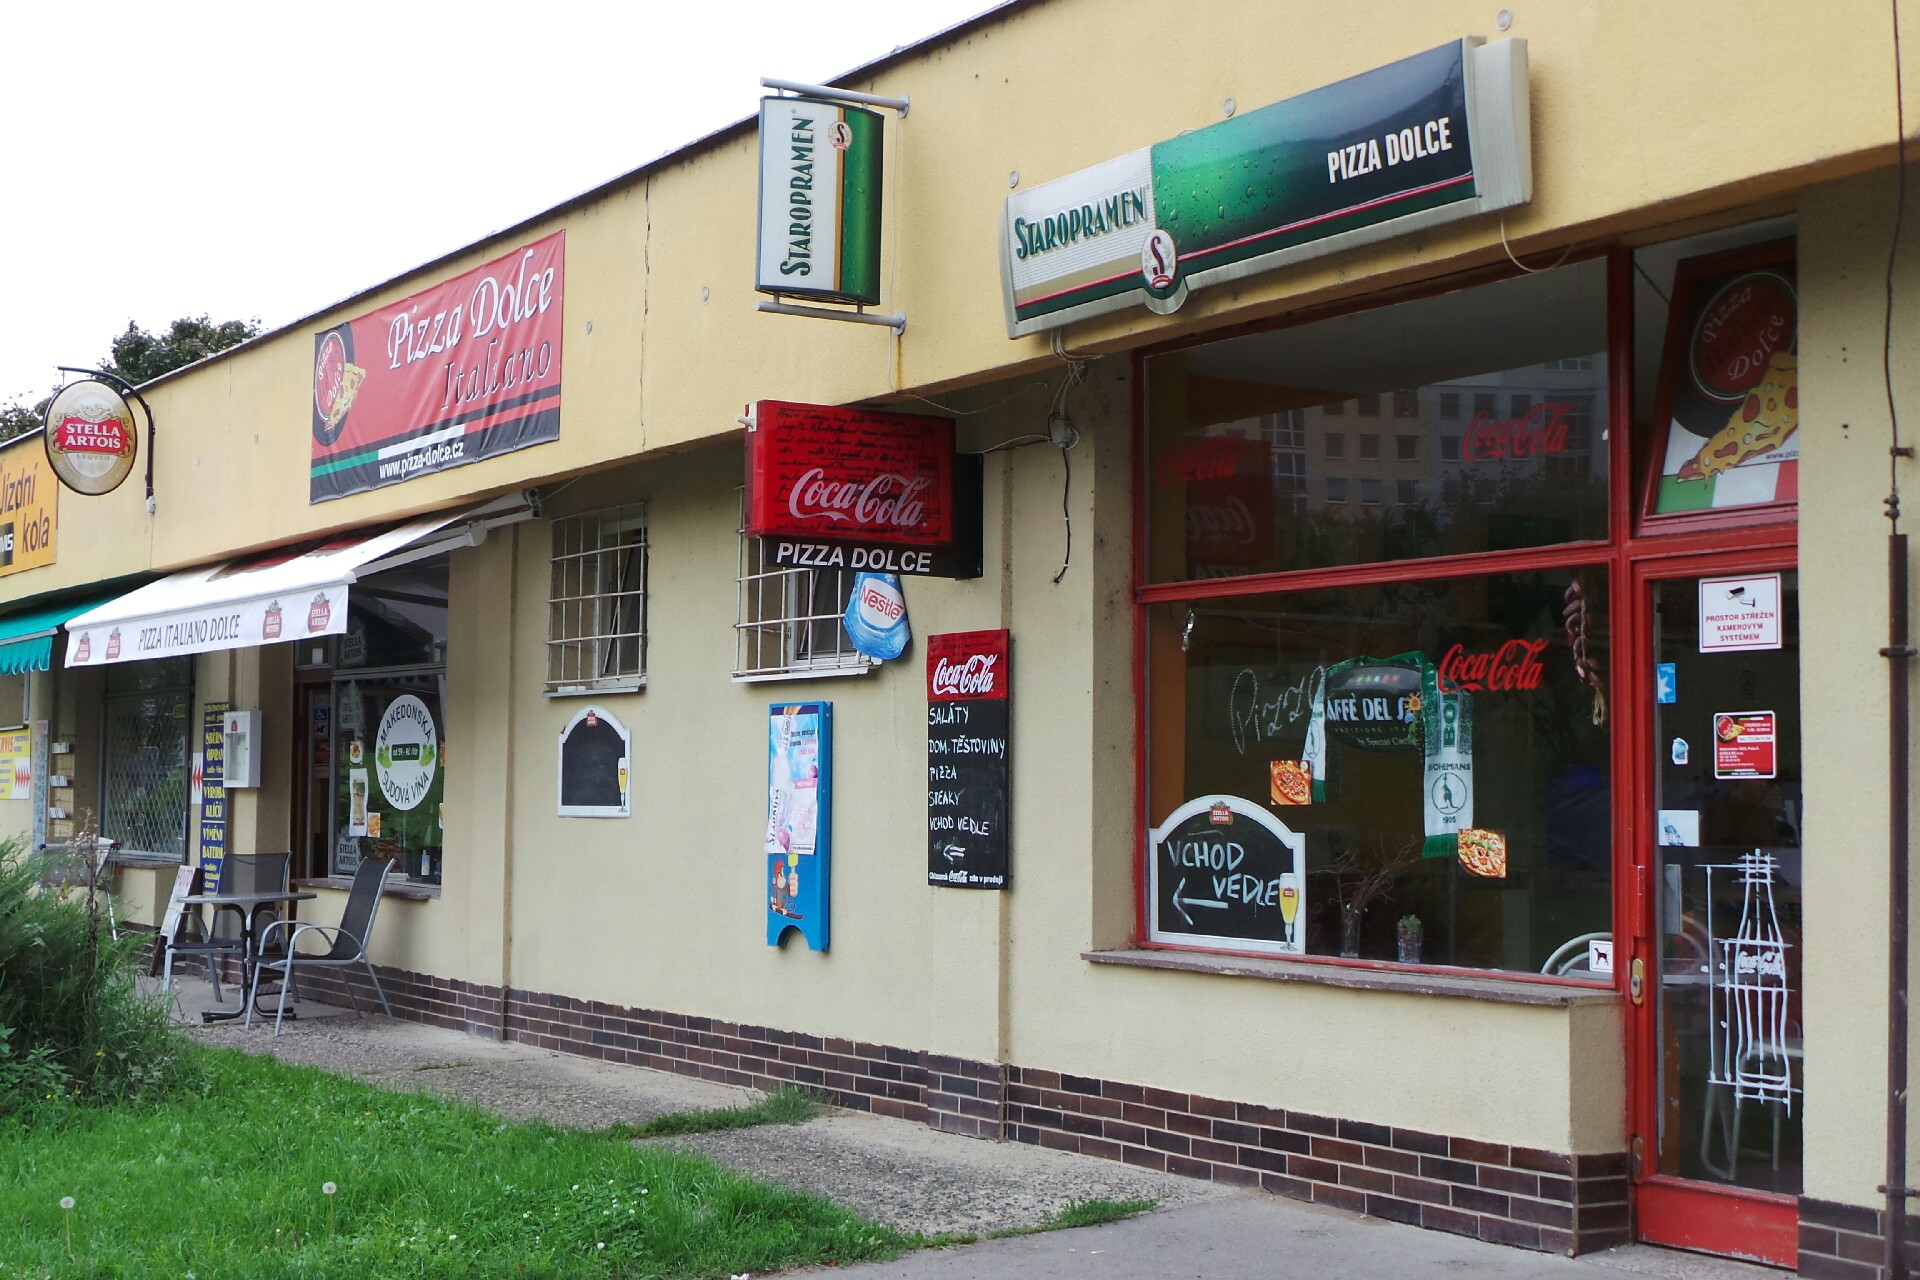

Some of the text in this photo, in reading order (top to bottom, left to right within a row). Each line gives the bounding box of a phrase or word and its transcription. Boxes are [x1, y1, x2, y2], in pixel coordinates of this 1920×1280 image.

[1327, 117, 1453, 183] PIZZA DOLCE
[780, 117, 814, 276] STAROPRAMEN
[1015, 184, 1147, 260] STAROPRAMEN
[388, 249, 554, 370] Pizza Dolce
[1703, 286, 1752, 343] Pizza
[1728, 313, 1785, 381] Dolce
[440, 337, 552, 412] Italiano
[65, 435, 121, 449] ARTOIS
[66, 423, 120, 437] STELLA
[1462, 401, 1573, 462] Coca-Cola
[379, 441, 464, 479] www.pizza-dolce.cz
[788, 467, 932, 527] Coca-Cola
[22, 508, 50, 554] kola
[776, 542, 932, 572] PIZZA DOLCE
[139, 614, 241, 650] PIZZA ITALIANO DOLCE
[1705, 611, 1775, 622] PROSTOR STŘEŽEN
[1716, 622, 1763, 632] KAMEROVÝM
[1720, 632, 1760, 642] SYSTÉMEM
[932, 654, 998, 695] Coca-Cola
[1437, 638, 1550, 694] Coca-Cola
[380, 704, 433, 745] MAKEDONSKÁ
[929, 702, 969, 725] SALÁTY
[1362, 697, 1393, 721] DEL
[951, 734, 1005, 759] TĚSTOVINY
[930, 765, 957, 781] PIZZA
[1428, 763, 1471, 771] BOHEMIANS
[382, 770, 429, 804] SUDOVÁ VÍNA
[929, 789, 963, 807] STEAKY
[930, 814, 990, 836] VCHOD VEDLE
[339, 844, 357, 855] STELLA
[1167, 840, 1244, 871] VCHOD
[1212, 873, 1280, 907] VEDLE
